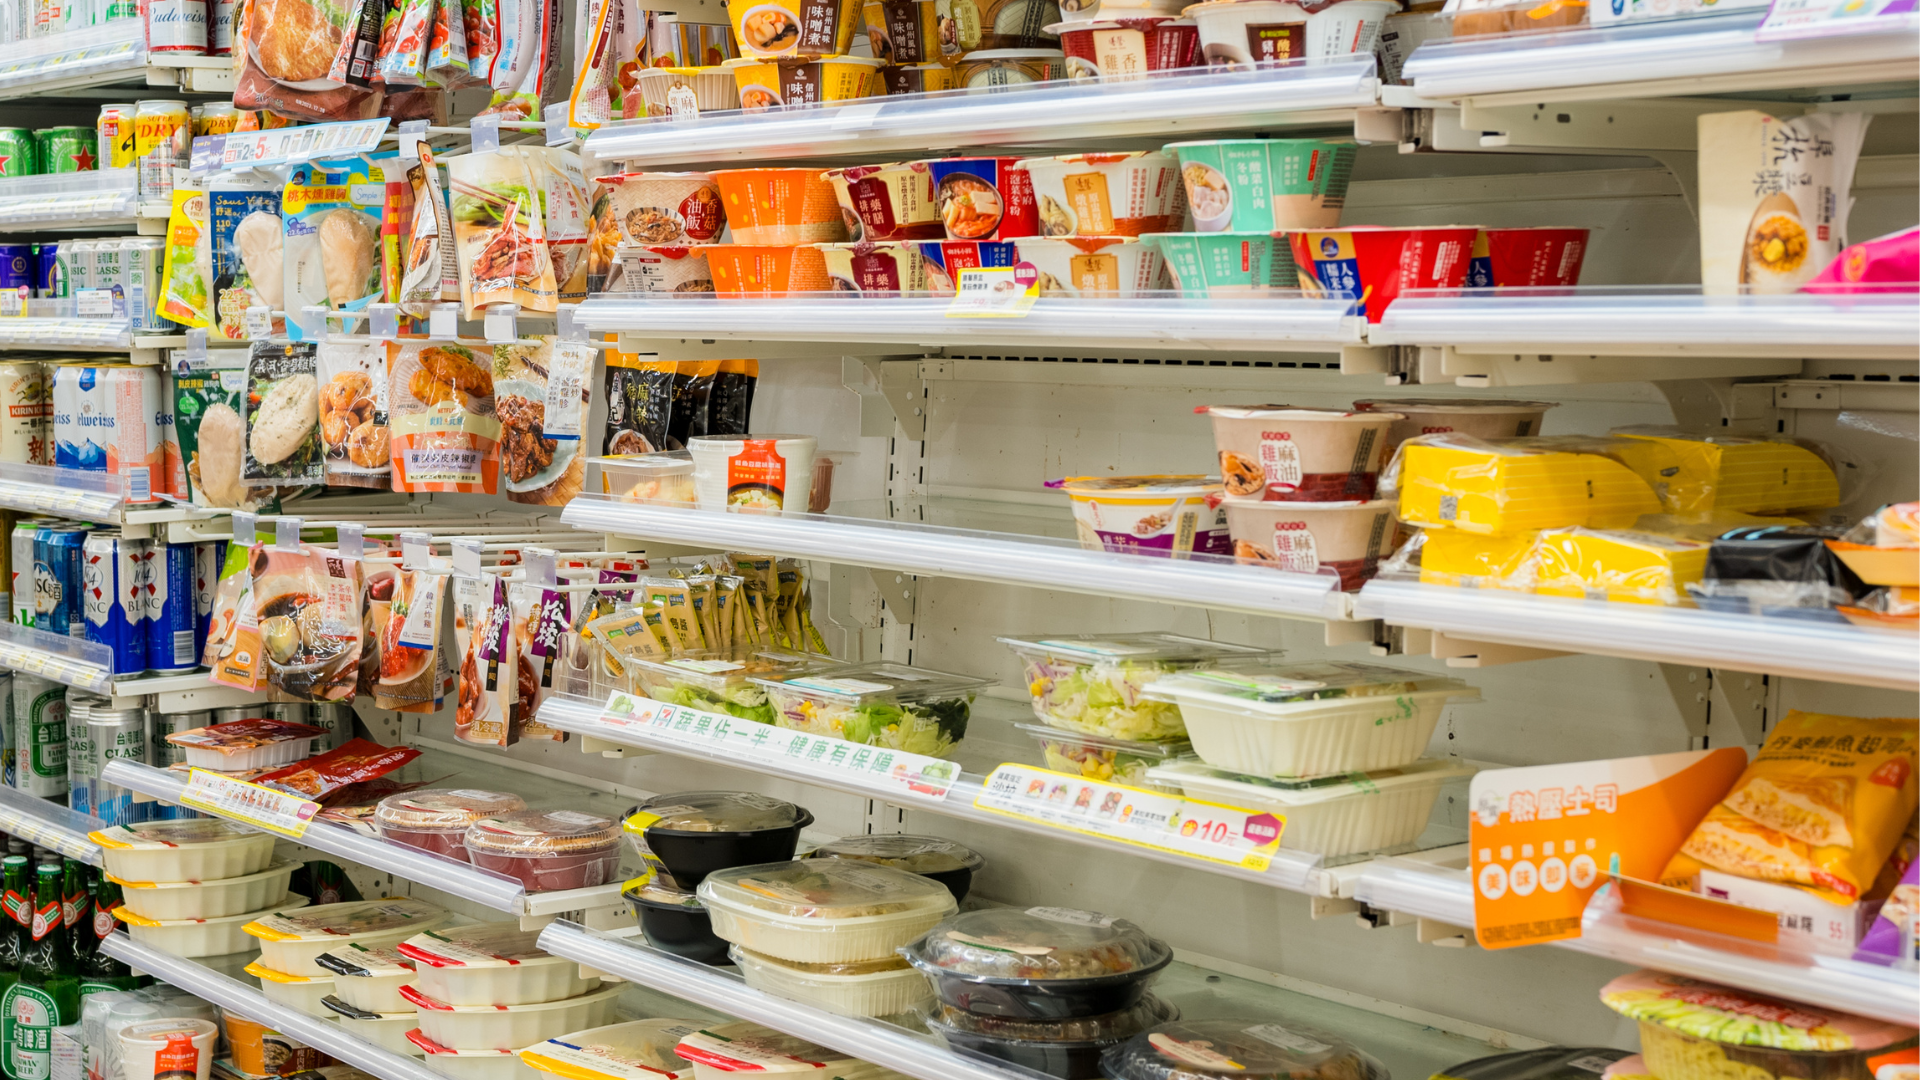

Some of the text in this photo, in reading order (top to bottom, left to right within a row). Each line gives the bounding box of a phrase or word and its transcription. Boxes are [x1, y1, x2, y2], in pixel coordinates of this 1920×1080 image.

[808, 5, 824, 46] 味噌煮
[822, 7, 834, 44] 信州風味
[894, 22, 908, 60] 味噌煮
[906, 22, 916, 57] 信州風味
[1237, 161, 1249, 186] 冬粉
[1249, 160, 1265, 210] 酸菜白肉
[215, 196, 245, 206] Sous
[909, 174, 917, 212] 使用漢方食材
[1009, 174, 1021, 217] 泡菜冬粉
[216, 219, 231, 228] 110
[686, 197, 702, 231] 油飯
[703, 199, 717, 232] 香菇
[870, 198, 884, 225] 藥膳
[11, 406, 34, 416] KIRIN
[1260, 443, 1278, 482] 雞飯
[1278, 443, 1298, 482] 麻油
[423, 591, 434, 629] 韓式炸雞
[470, 720, 503, 734] 須冷藏
[673, 710, 895, 775] 蔬果佔一半 健康有保障
[1483, 860, 1592, 891] 美味即享
